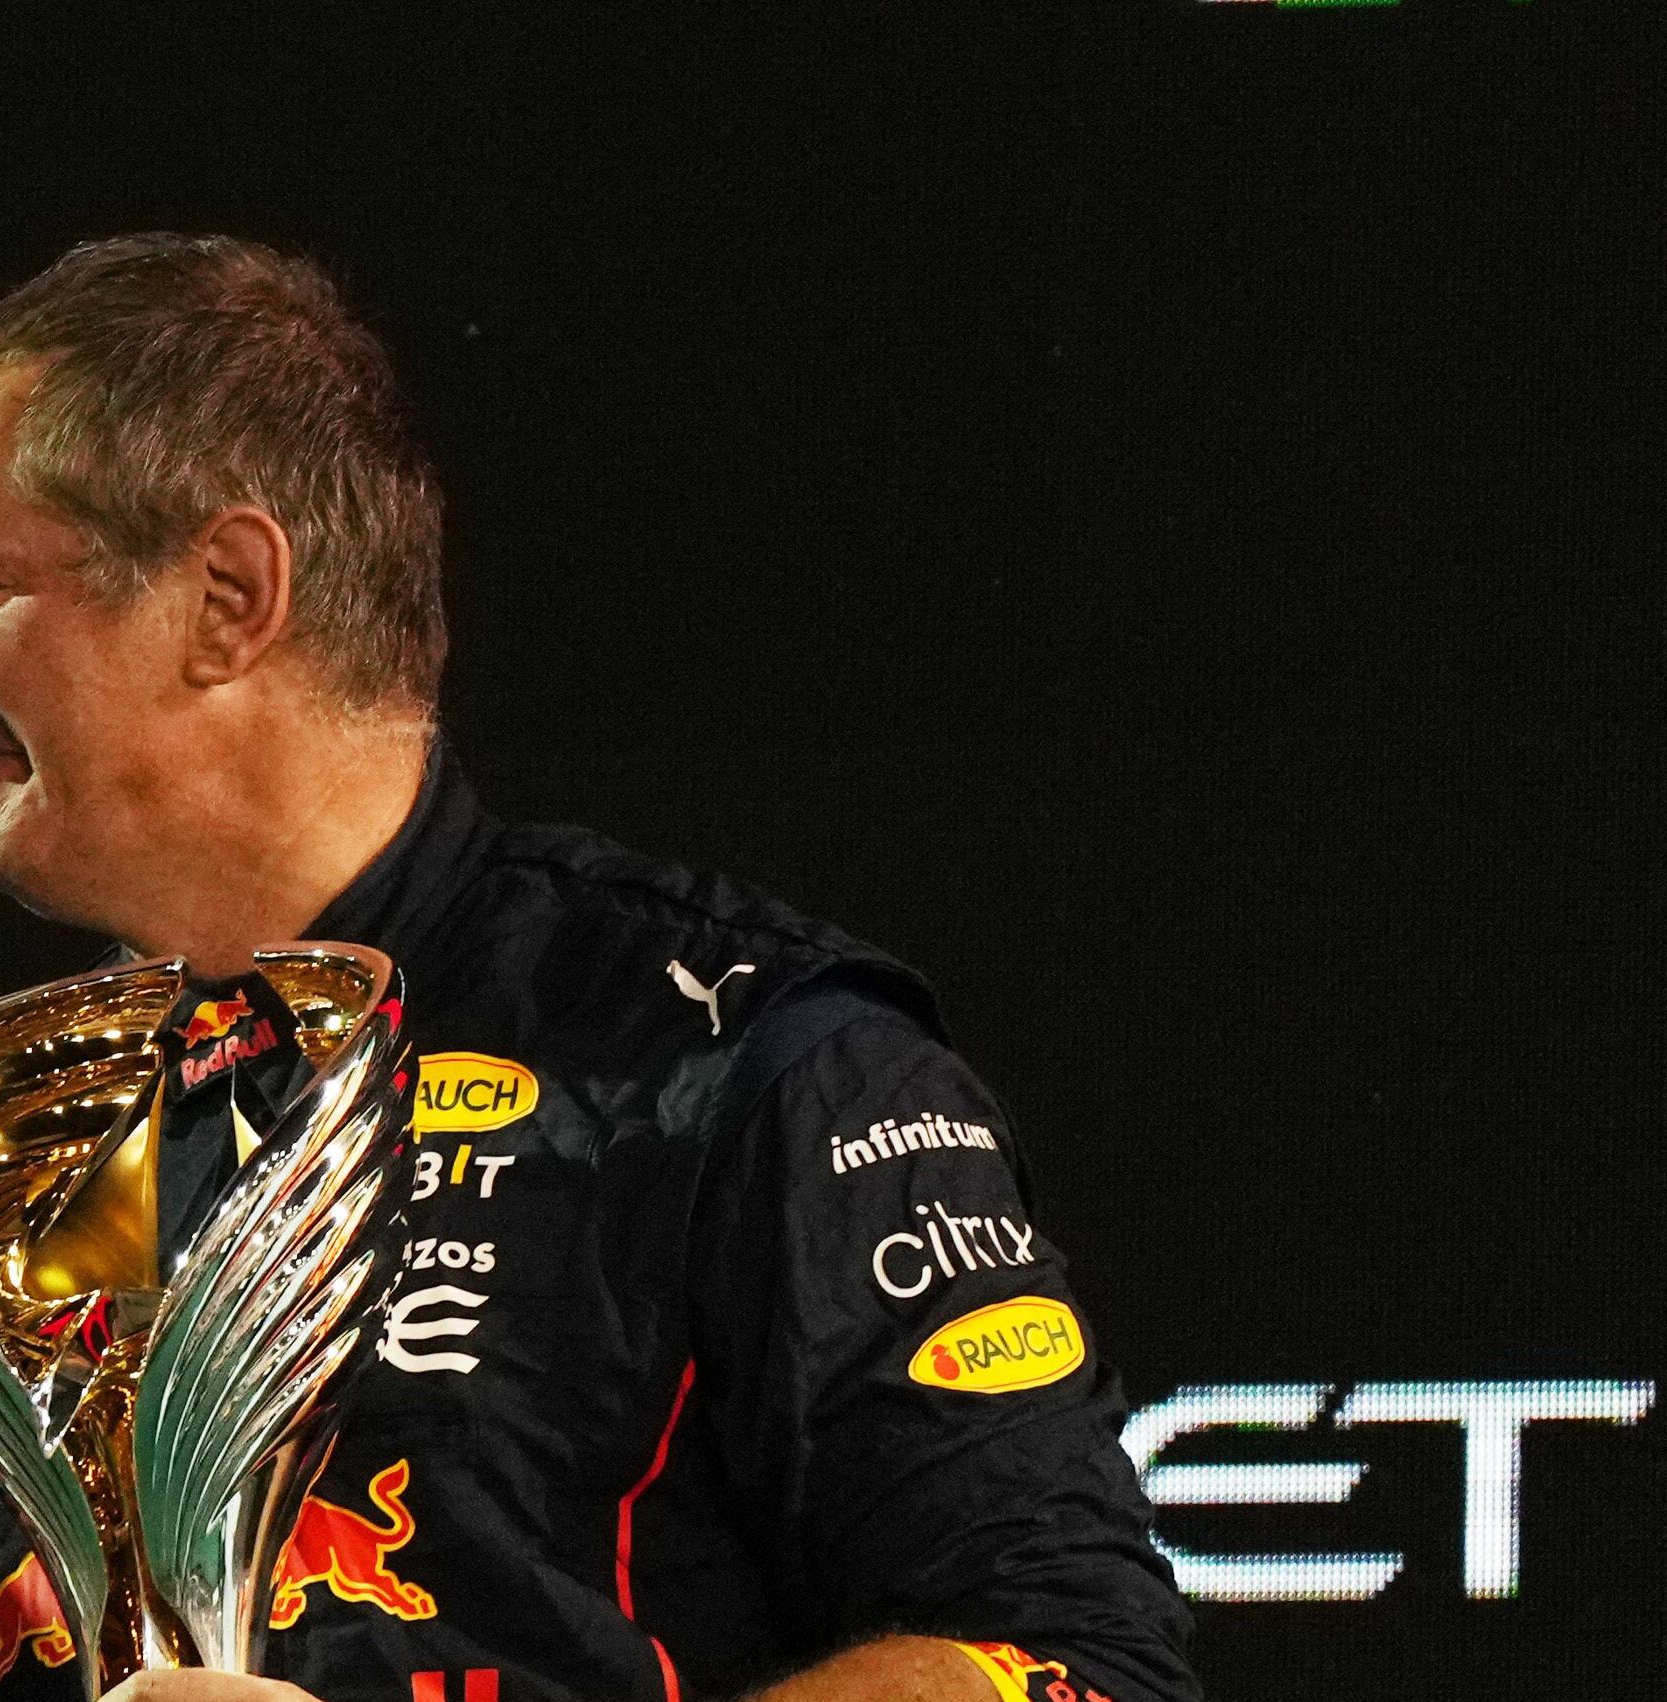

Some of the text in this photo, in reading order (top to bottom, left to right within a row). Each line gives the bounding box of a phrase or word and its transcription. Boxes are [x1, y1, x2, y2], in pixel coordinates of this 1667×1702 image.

[418, 1077, 519, 1112] AUCH
[830, 1111, 997, 1175] infinitum
[411, 1144, 516, 1202] BIT
[402, 1237, 497, 1274] zos
[956, 1316, 1074, 1374] RAUCH
